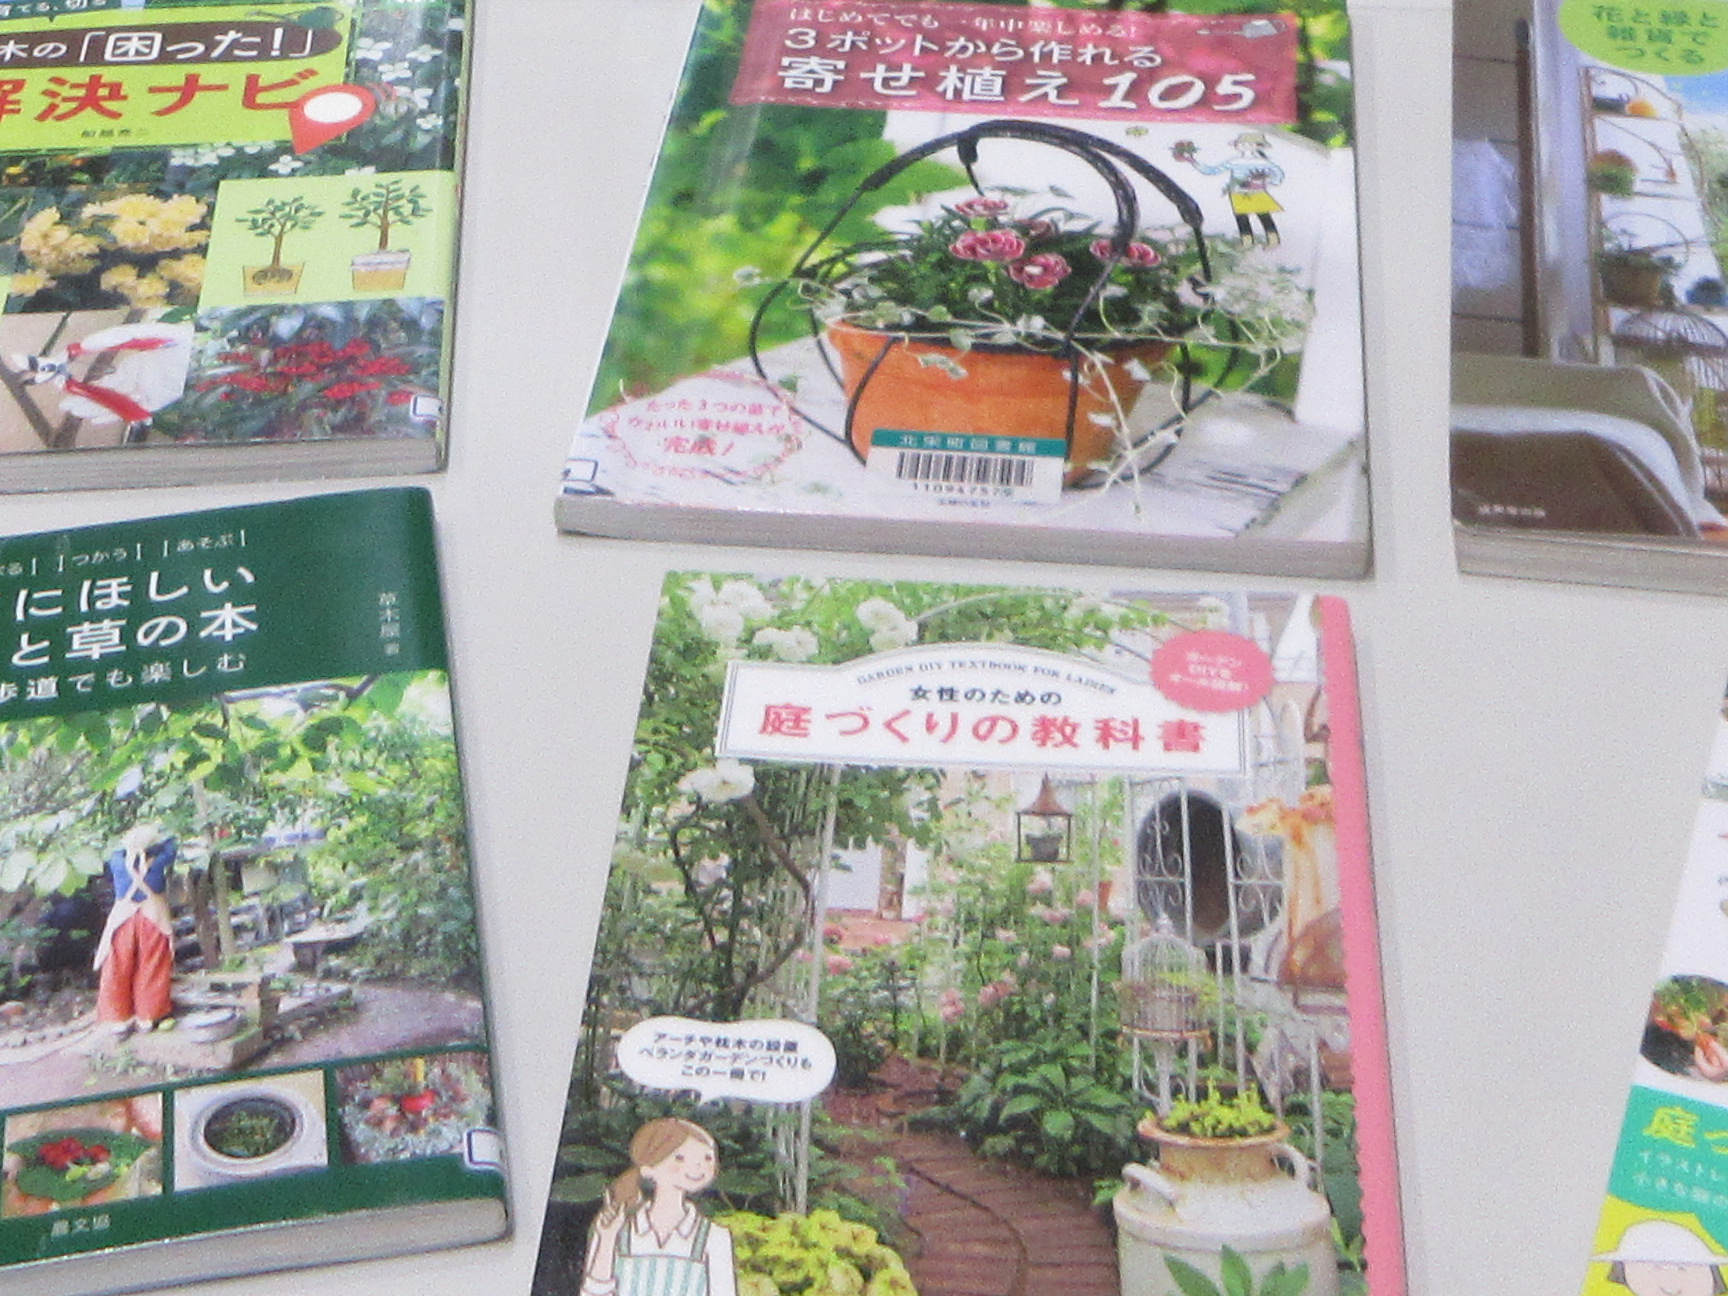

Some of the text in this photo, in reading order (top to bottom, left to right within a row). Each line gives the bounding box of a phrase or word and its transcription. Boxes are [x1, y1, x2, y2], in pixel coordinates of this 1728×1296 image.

[789, 8, 940, 30] はじめてでも
[783, 26, 1164, 69] 3ポットから作れる
[777, 56, 1257, 111] 寄せ植え105
[70, 544, 129, 567] つかう
[948, 659, 1026, 673] TEXTBOOK
[1032, 664, 1062, 678] FOR
[909, 685, 1063, 705] 女性のための
[757, 702, 1209, 754] 庭づくりの教科書
